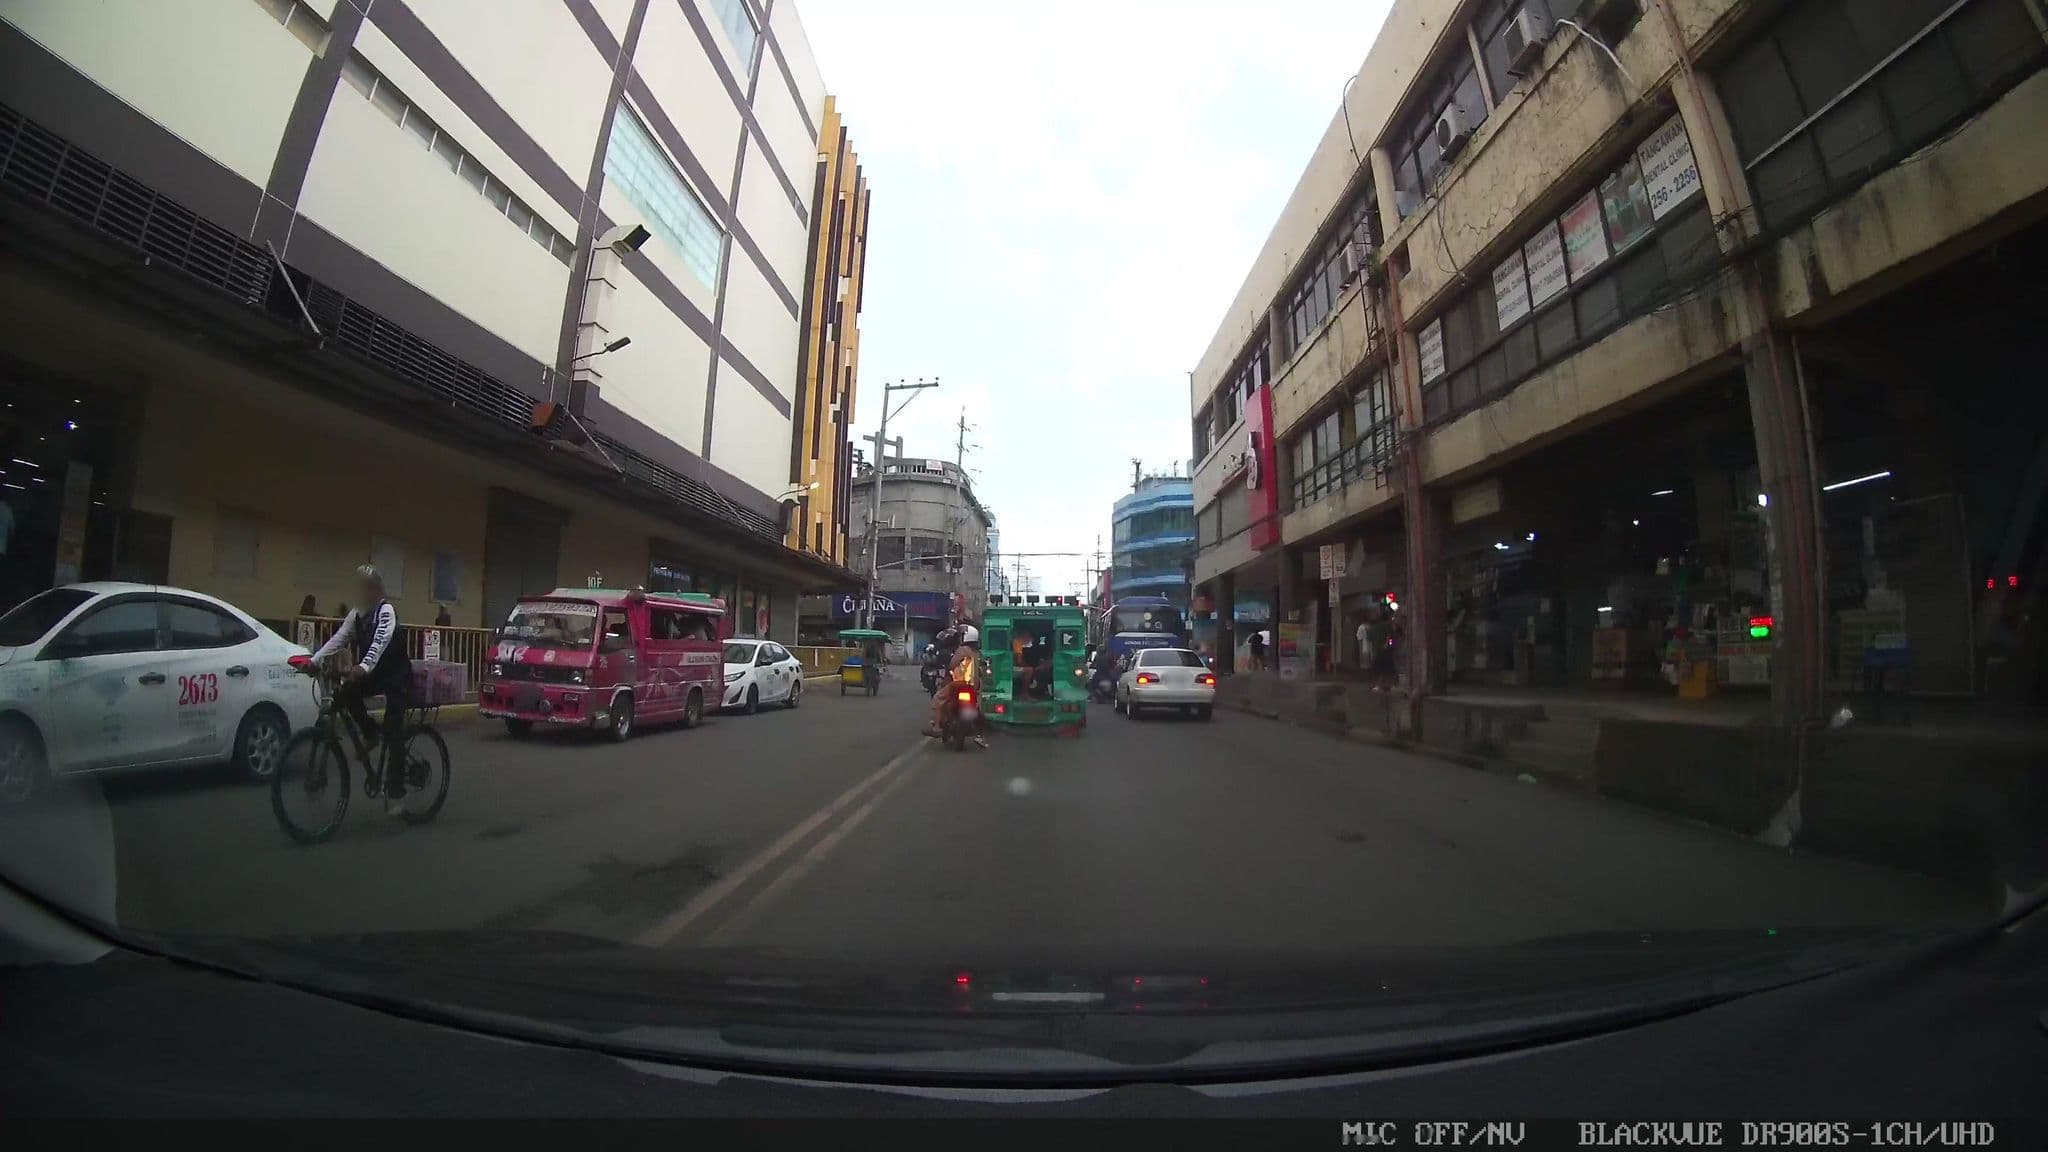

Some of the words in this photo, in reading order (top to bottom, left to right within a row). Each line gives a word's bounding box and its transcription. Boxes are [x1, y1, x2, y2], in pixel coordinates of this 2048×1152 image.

[1643, 161, 1669, 185] DENTAL
[1668, 142, 1690, 166] CLINIC
[178, 673, 218, 705] 2673
